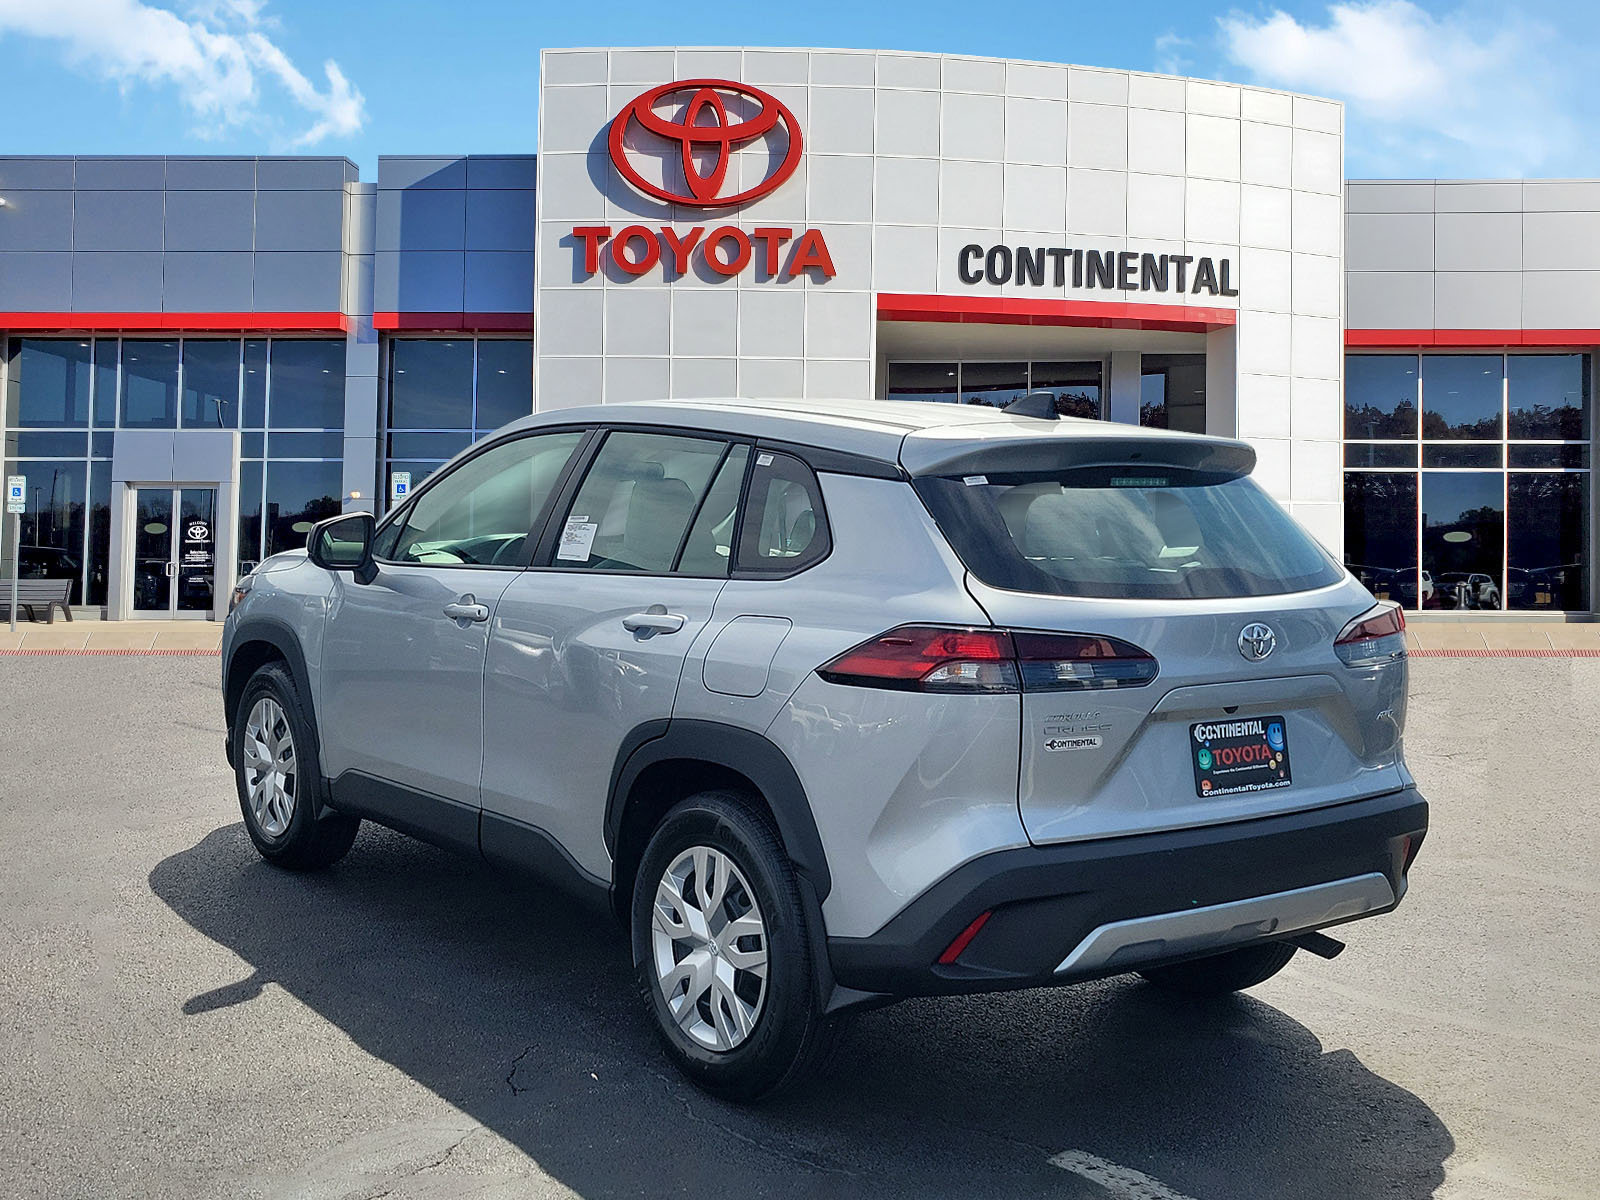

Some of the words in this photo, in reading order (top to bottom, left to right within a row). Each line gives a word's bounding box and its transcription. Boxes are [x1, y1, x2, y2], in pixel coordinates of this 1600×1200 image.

[572, 225, 837, 277] TOYOTA
[958, 244, 1239, 297] CONTINENTAL
[1194, 720, 1265, 742] CONTINENTAL
[1048, 738, 1098, 750] CONTINENTAL
[1212, 744, 1272, 766] TOYOTA
[1202, 780, 1291, 797] ContinentalToyota.com
